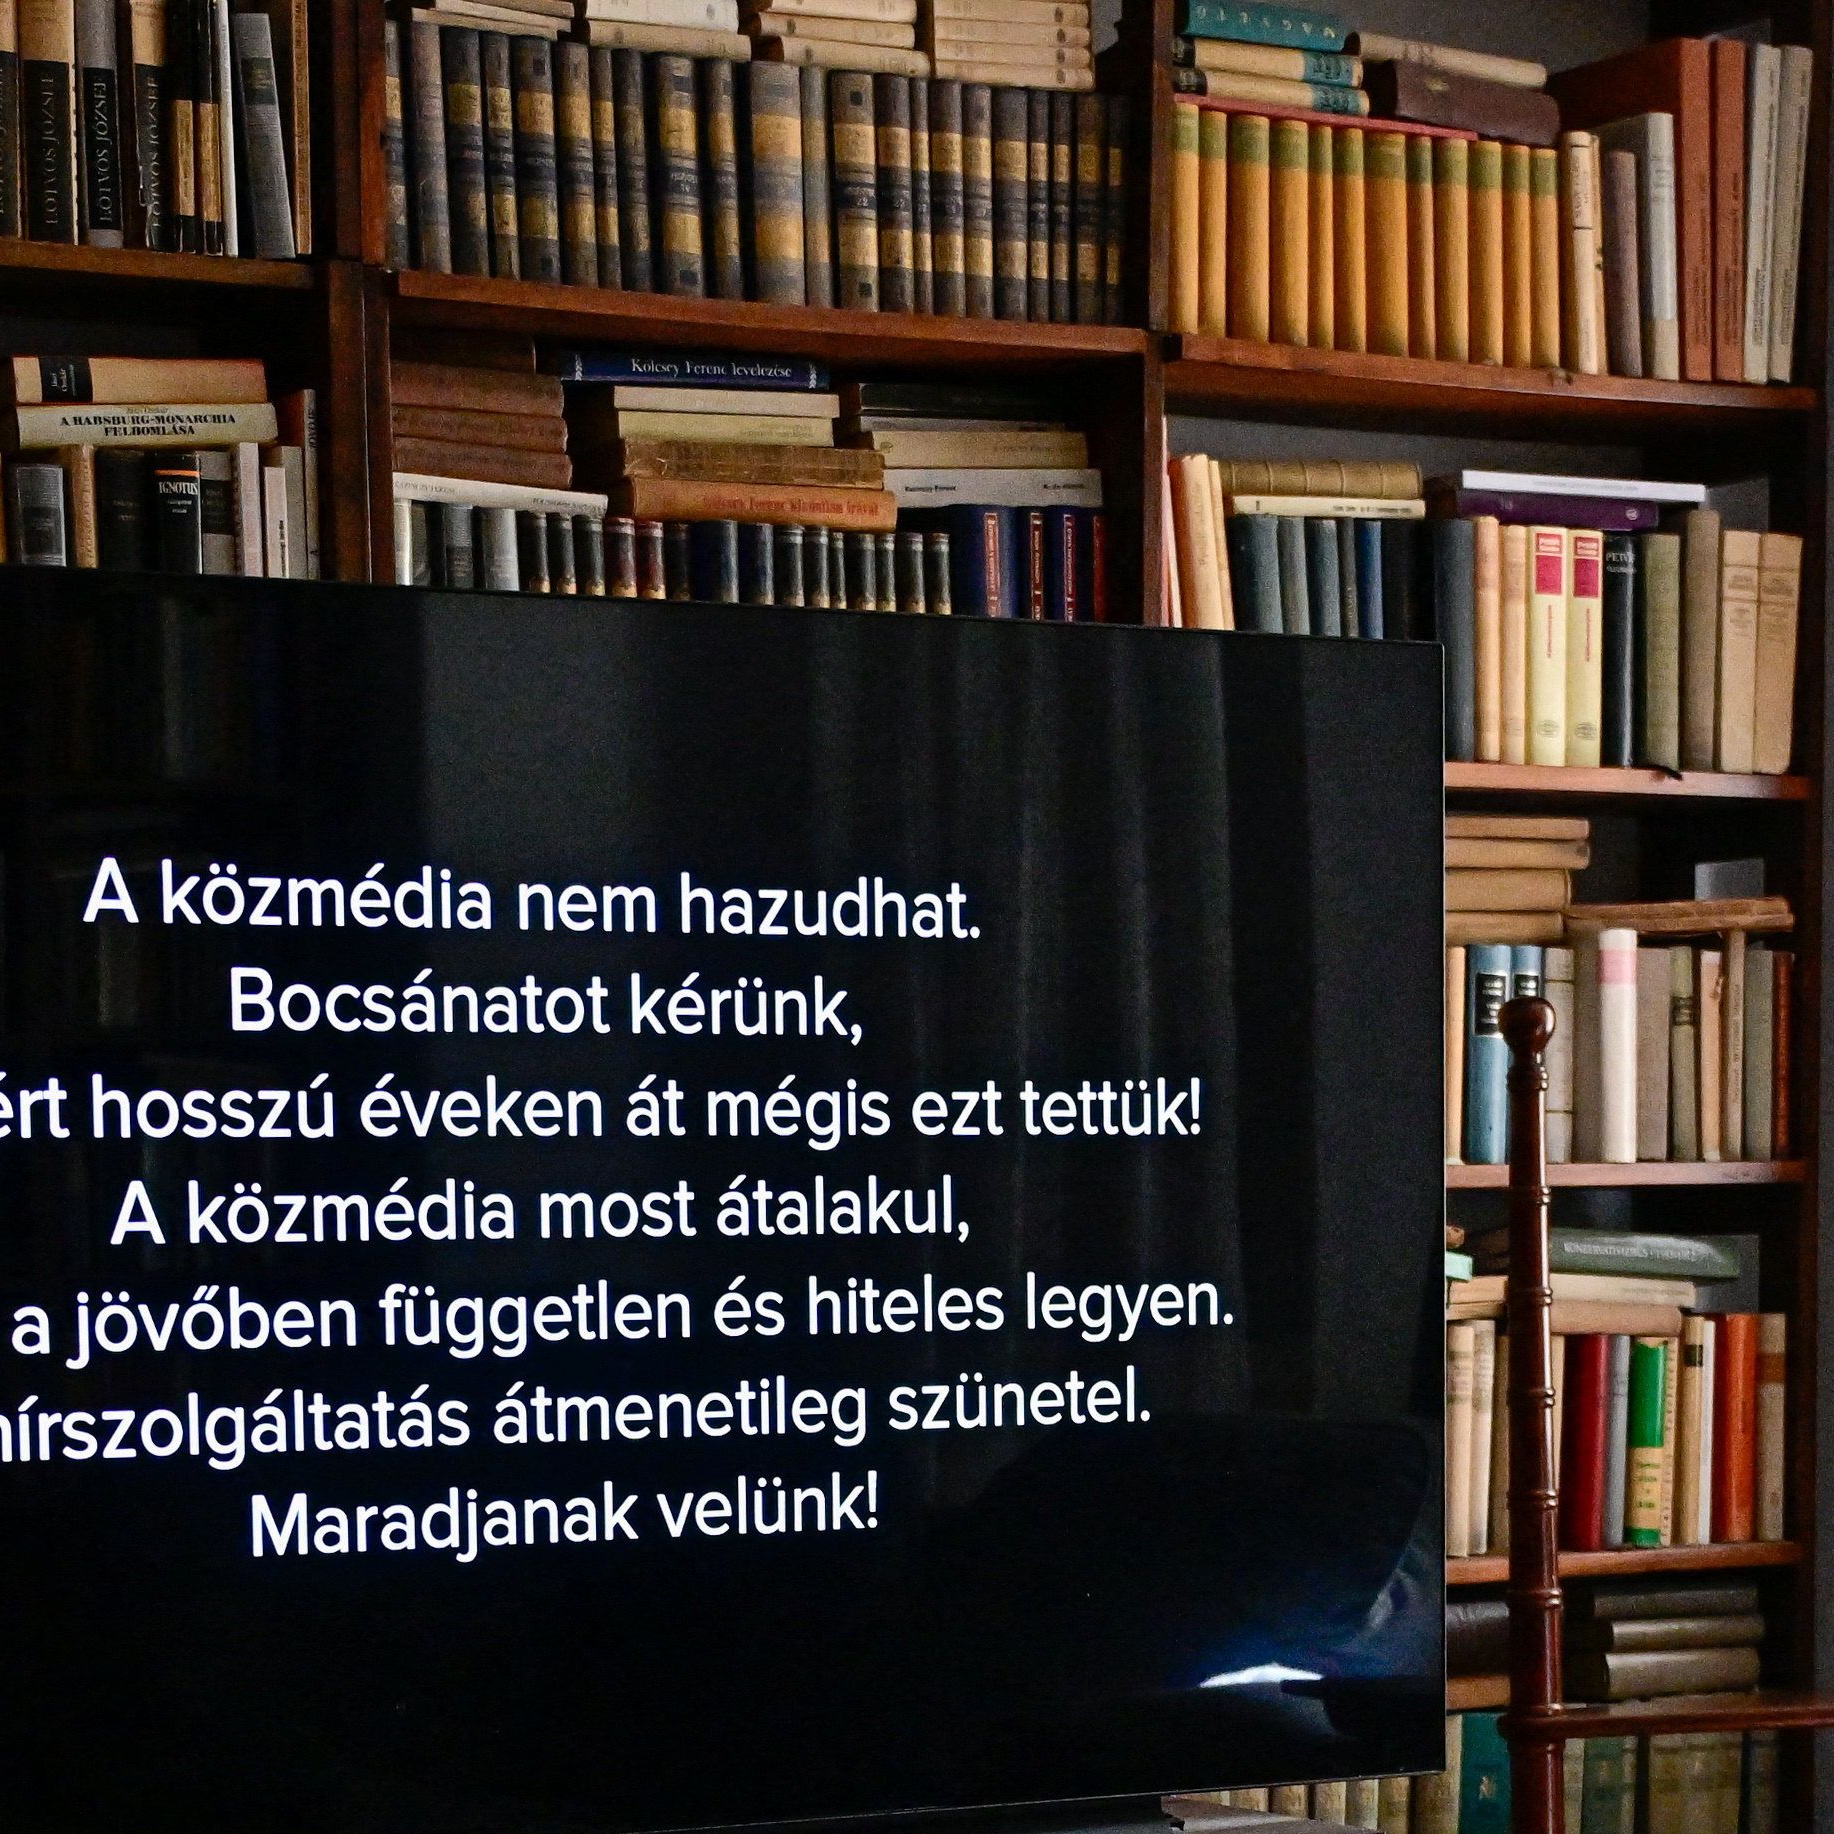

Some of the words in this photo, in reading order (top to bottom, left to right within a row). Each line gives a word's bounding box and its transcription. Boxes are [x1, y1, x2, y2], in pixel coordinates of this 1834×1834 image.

[631, 357, 679, 379] Kölcsey
[685, 361, 725, 376] Ferenc
[731, 362, 792, 379] levelezése
[73, 414, 235, 426] HABSBURG-MONARCHIA
[104, 424, 195, 437] FELBOMLÁSA
[159, 482, 198, 495] IGNOTUS
[83, 857, 139, 923] A
[162, 859, 491, 929] közmédia
[519, 883, 656, 932] nem
[681, 872, 980, 938] hazudhat.
[231, 967, 610, 1033] Bocsánatot
[631, 972, 862, 1046] kérünk,
[92, 1073, 333, 1138] hosszú
[360, 1073, 602, 1137] éveken
[627, 1074, 686, 1136] át
[708, 1075, 890, 1150] mégis
[912, 1080, 1004, 1135] ezt
[1020, 1077, 1200, 1136] tettük!
[110, 1180, 166, 1244] A
[188, 1177, 514, 1243] közmédia
[540, 1181, 697, 1238] most
[717, 1174, 969, 1243] átalakul,
[12, 1306, 50, 1354] a
[66, 1285, 356, 1369] jövőben
[379, 1279, 690, 1359] független
[714, 1275, 785, 1336] és
[809, 1274, 1004, 1334] hiteles
[1027, 1272, 1233, 1342] legyen.
[494, 1375, 866, 1446] átmenetileg
[889, 1365, 1150, 1430] szünetel.
[252, 1481, 638, 1562] Maradjanak
[657, 1470, 877, 1537] velünk!
